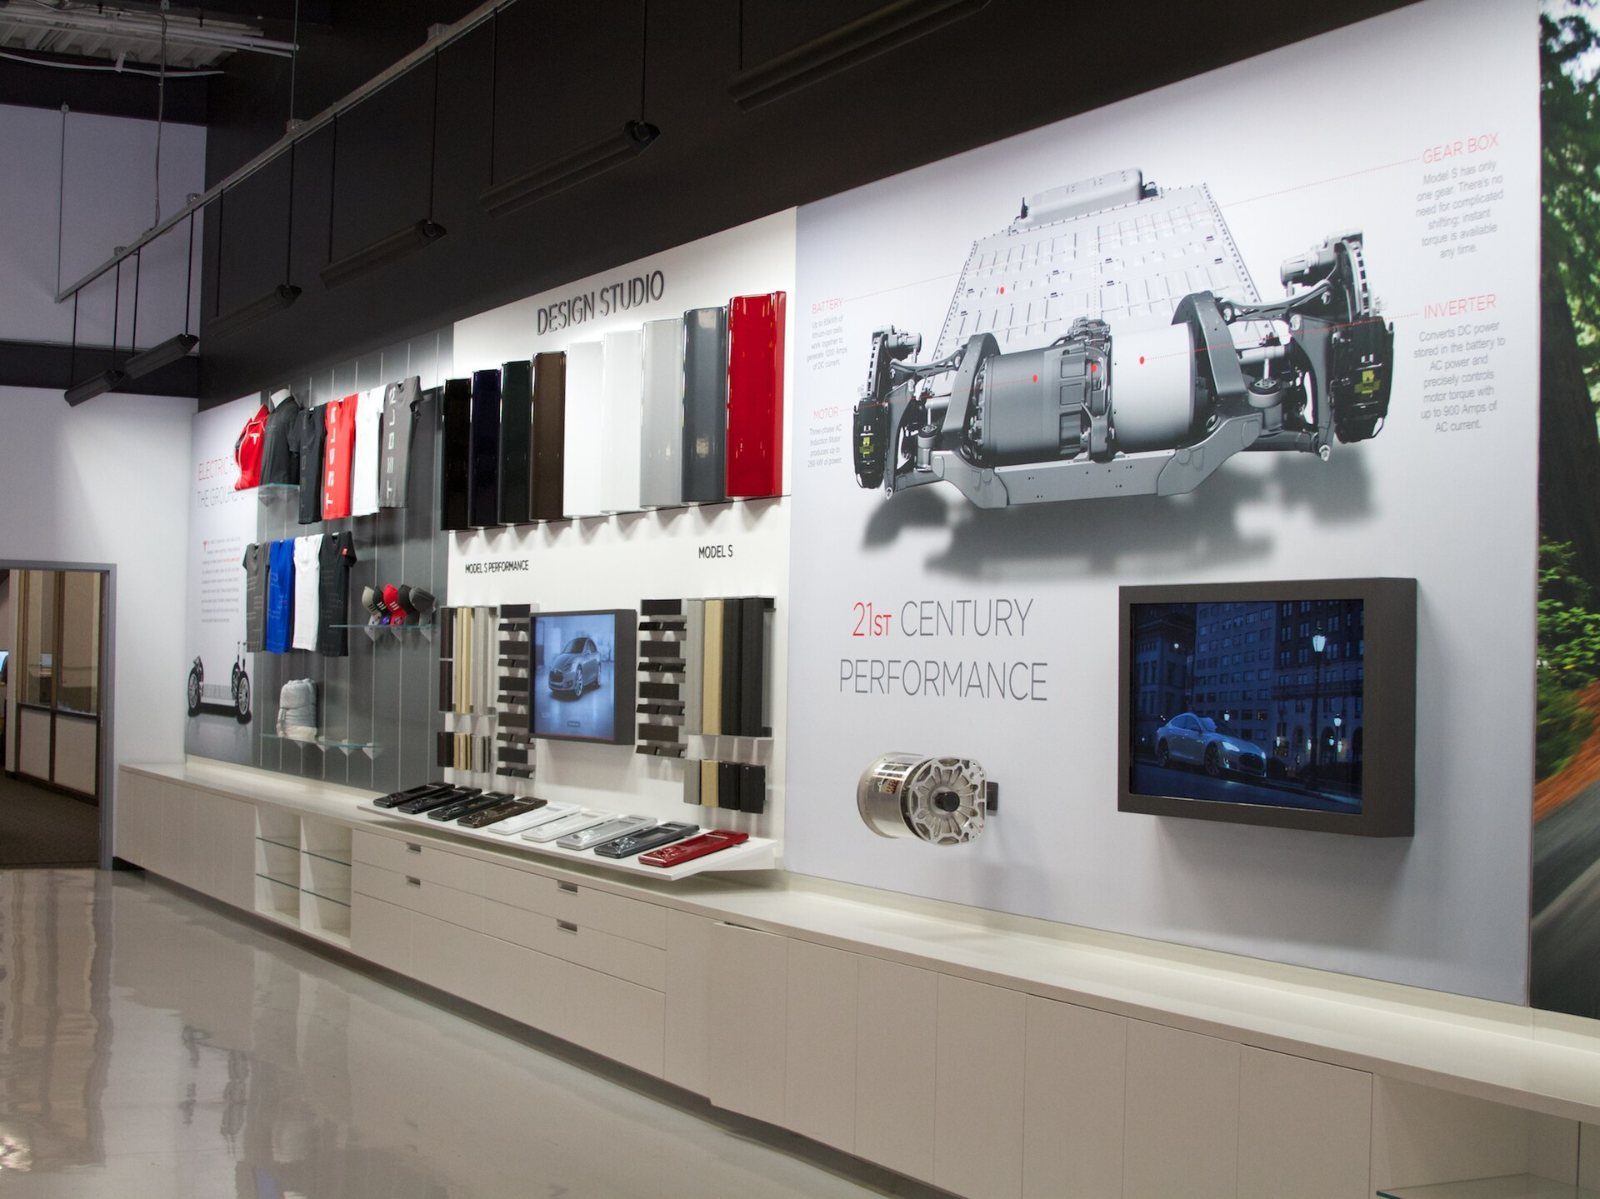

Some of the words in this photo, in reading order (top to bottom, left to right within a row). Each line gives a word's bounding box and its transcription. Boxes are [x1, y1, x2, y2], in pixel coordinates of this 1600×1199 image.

[1422, 141, 1464, 164] GEAR
[1467, 132, 1500, 154] BOX
[1423, 170, 1449, 184] Model
[1451, 167, 1458, 179] S
[1460, 165, 1476, 177] has
[1478, 160, 1497, 173] only
[1416, 191, 1432, 202] one
[1491, 174, 1503, 185] no
[1416, 203, 1436, 217] need
[1438, 201, 1450, 212] for
[1452, 188, 1504, 210] complicated
[1462, 208, 1491, 223] instant
[1421, 233, 1448, 247] torque
[1451, 231, 1458, 241] is
[1460, 223, 1498, 239] available
[1440, 248, 1455, 259] any
[537, 291, 595, 336] DESIGN
[600, 270, 665, 317] STUDIO
[811, 297, 844, 314] BATTERY
[1424, 293, 1496, 320] INVERTER
[1418, 327, 1456, 343] Converts
[1457, 324, 1472, 337] DC
[1473, 321, 1500, 336] power
[1413, 345, 1439, 359] stored
[1440, 343, 1448, 355] in
[1450, 342, 1463, 354] the
[1465, 339, 1495, 352] battery
[1497, 337, 1506, 346] to
[1429, 359, 1442, 372] AC
[1444, 356, 1470, 371] power
[1472, 354, 1488, 366] and
[1423, 374, 1460, 389] precisely
[1461, 369, 1495, 384] controls
[1423, 391, 1447, 403] motor
[1448, 388, 1475, 401] torque
[1477, 385, 1495, 397] with
[813, 406, 839, 420] MOTOR
[1420, 409, 1431, 420] up
[1433, 407, 1441, 418] to
[1443, 404, 1460, 417] 900
[1461, 402, 1487, 415] Amps
[1489, 400, 1498, 411] of
[1435, 421, 1448, 433] AC
[698, 546, 726, 559] MODEL
[727, 544, 733, 558] S
[464, 563, 483, 574] MODEL
[483, 562, 488, 573] S
[488, 560, 530, 573] PERFORMANCE
[852, 601, 892, 637] 21ST
[900, 598, 1035, 637] CENTURY
[839, 658, 1049, 701] PERFORMANCE
